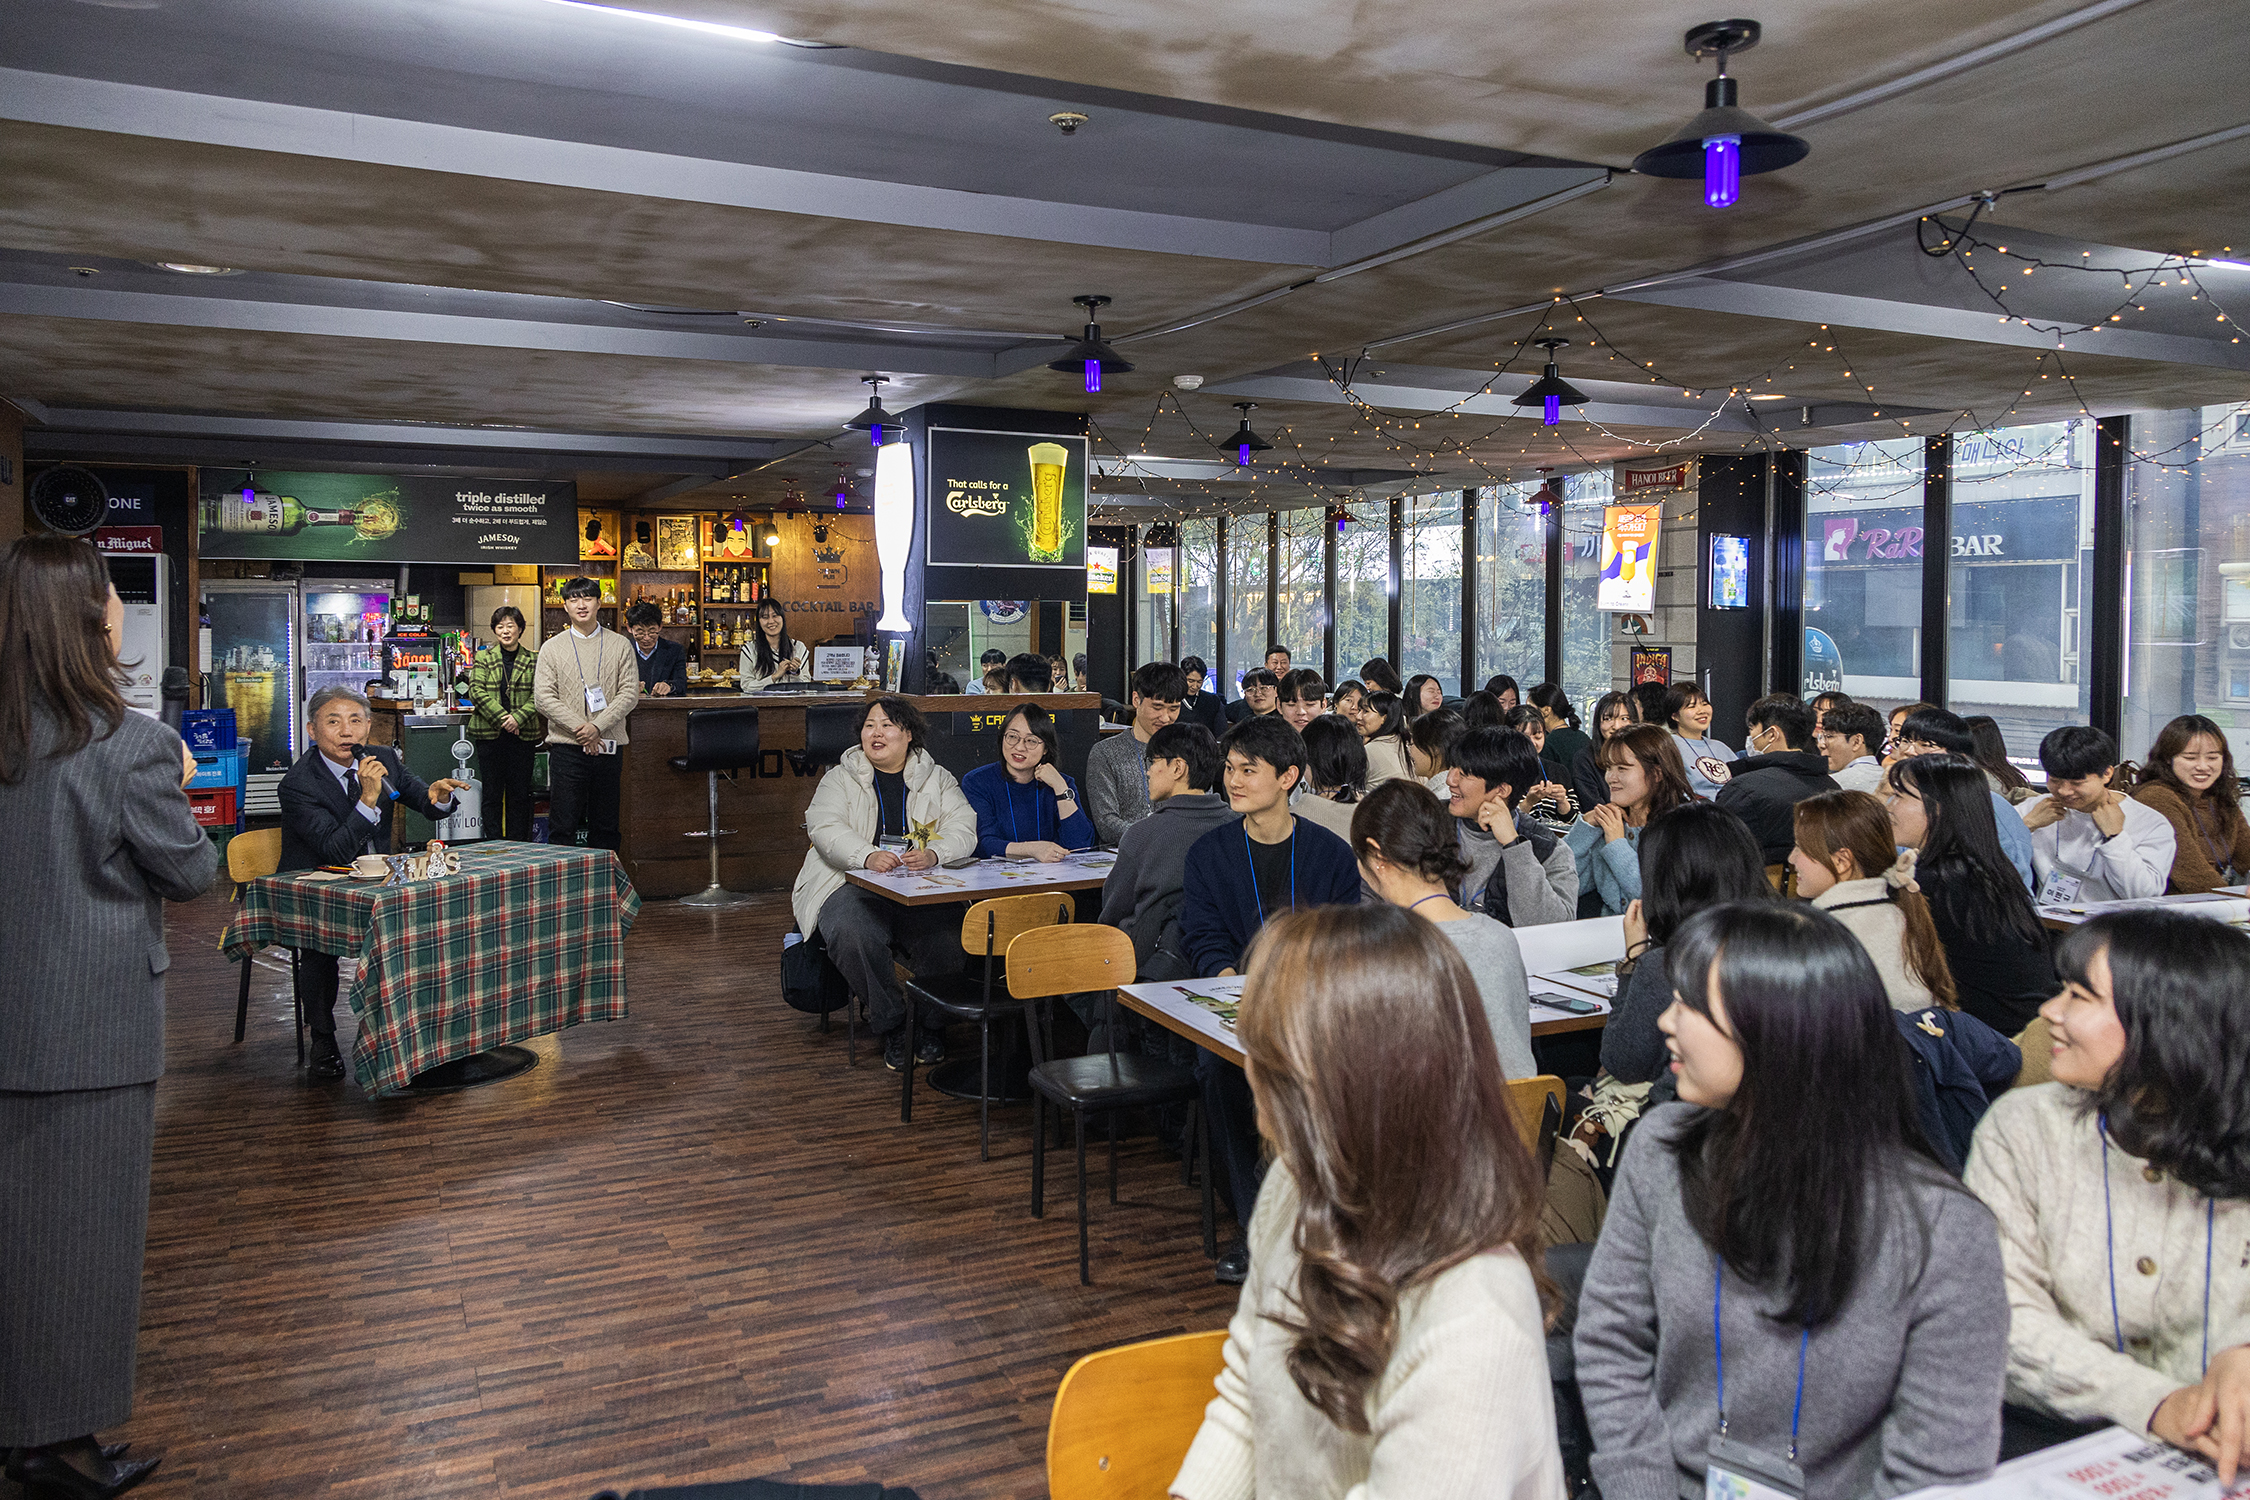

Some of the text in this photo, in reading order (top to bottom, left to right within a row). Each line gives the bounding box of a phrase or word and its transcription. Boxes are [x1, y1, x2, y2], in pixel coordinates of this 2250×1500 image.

[946, 478, 968, 489] That
[968, 480, 988, 490] calls
[989, 481, 1001, 490] for
[1631, 471, 1656, 486] HANOI
[455, 491, 546, 505] triple distilled
[946, 491, 1006, 517] Carlsberg
[463, 503, 490, 512] twice
[504, 505, 538, 513] smooth
[106, 536, 153, 551] Miguel
[477, 533, 521, 545] JAMESON
[1861, 526, 2004, 560] RaR BAR
[782, 601, 874, 613] COCKTAIL BAR
